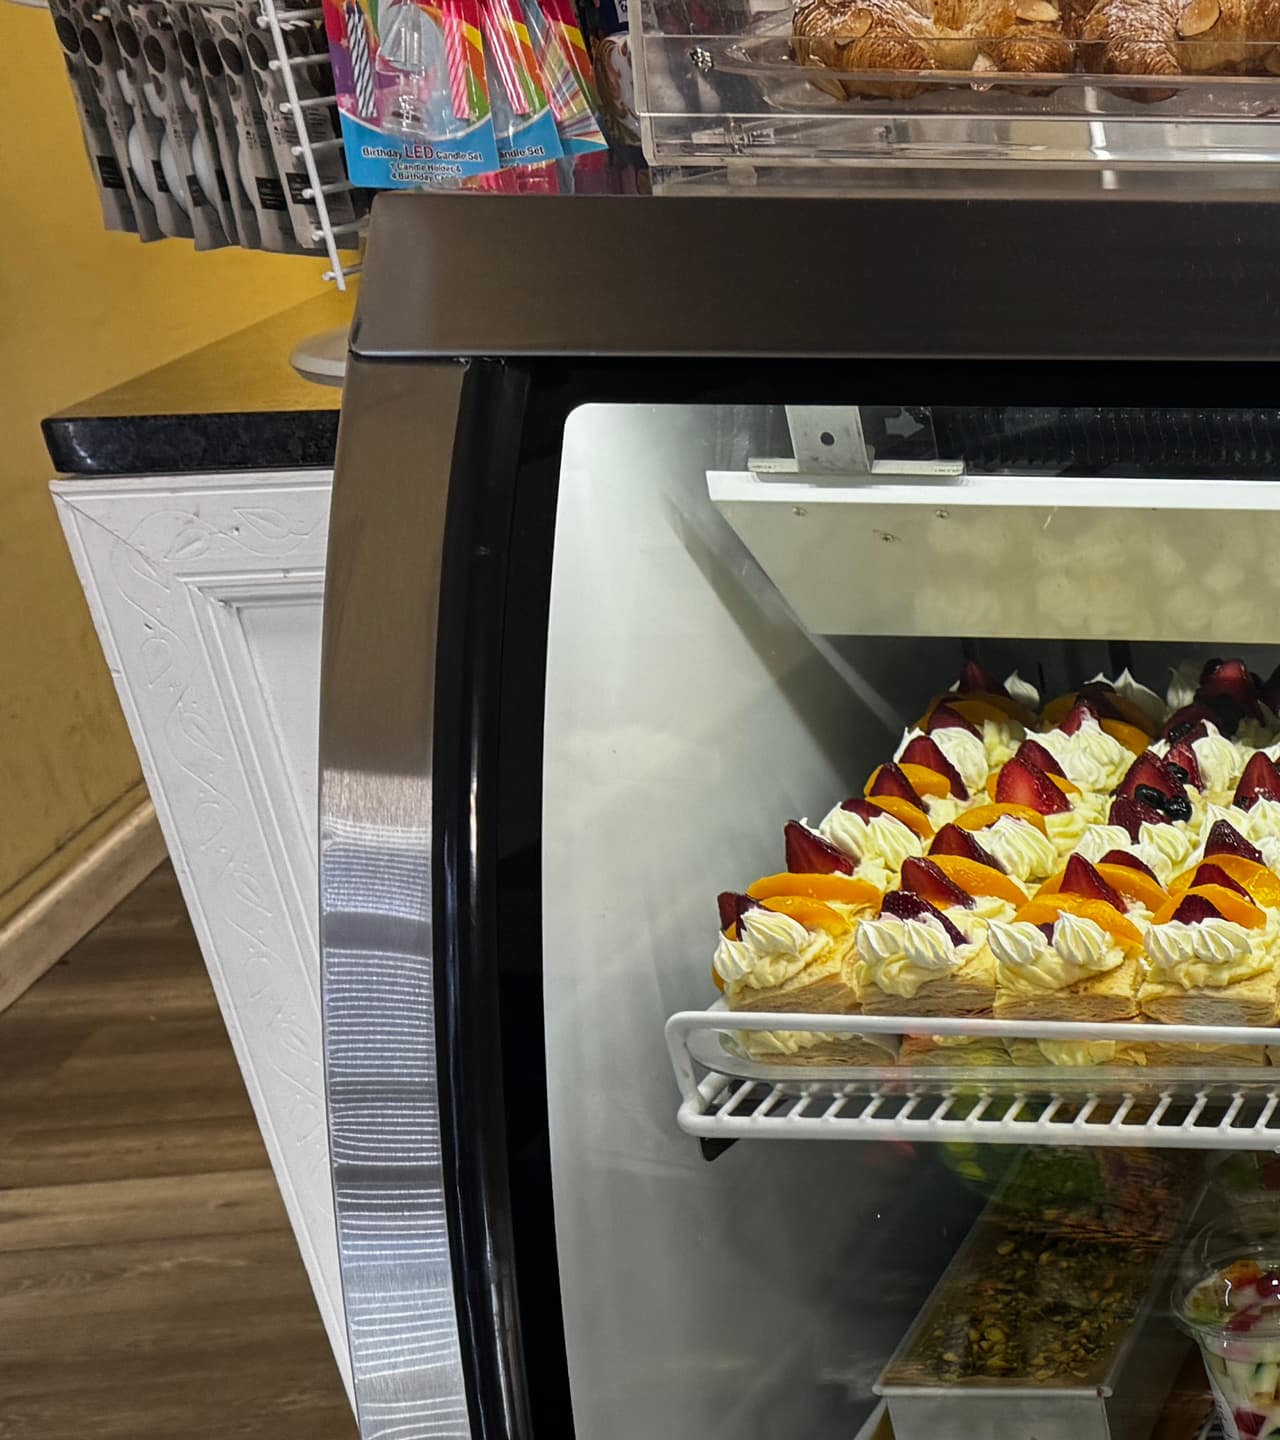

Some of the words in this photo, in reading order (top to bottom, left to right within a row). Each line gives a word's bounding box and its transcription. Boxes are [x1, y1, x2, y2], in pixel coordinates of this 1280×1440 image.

[362, 146, 402, 160] Birthday
[404, 144, 434, 159] LED
[500, 148, 527, 158] andle
